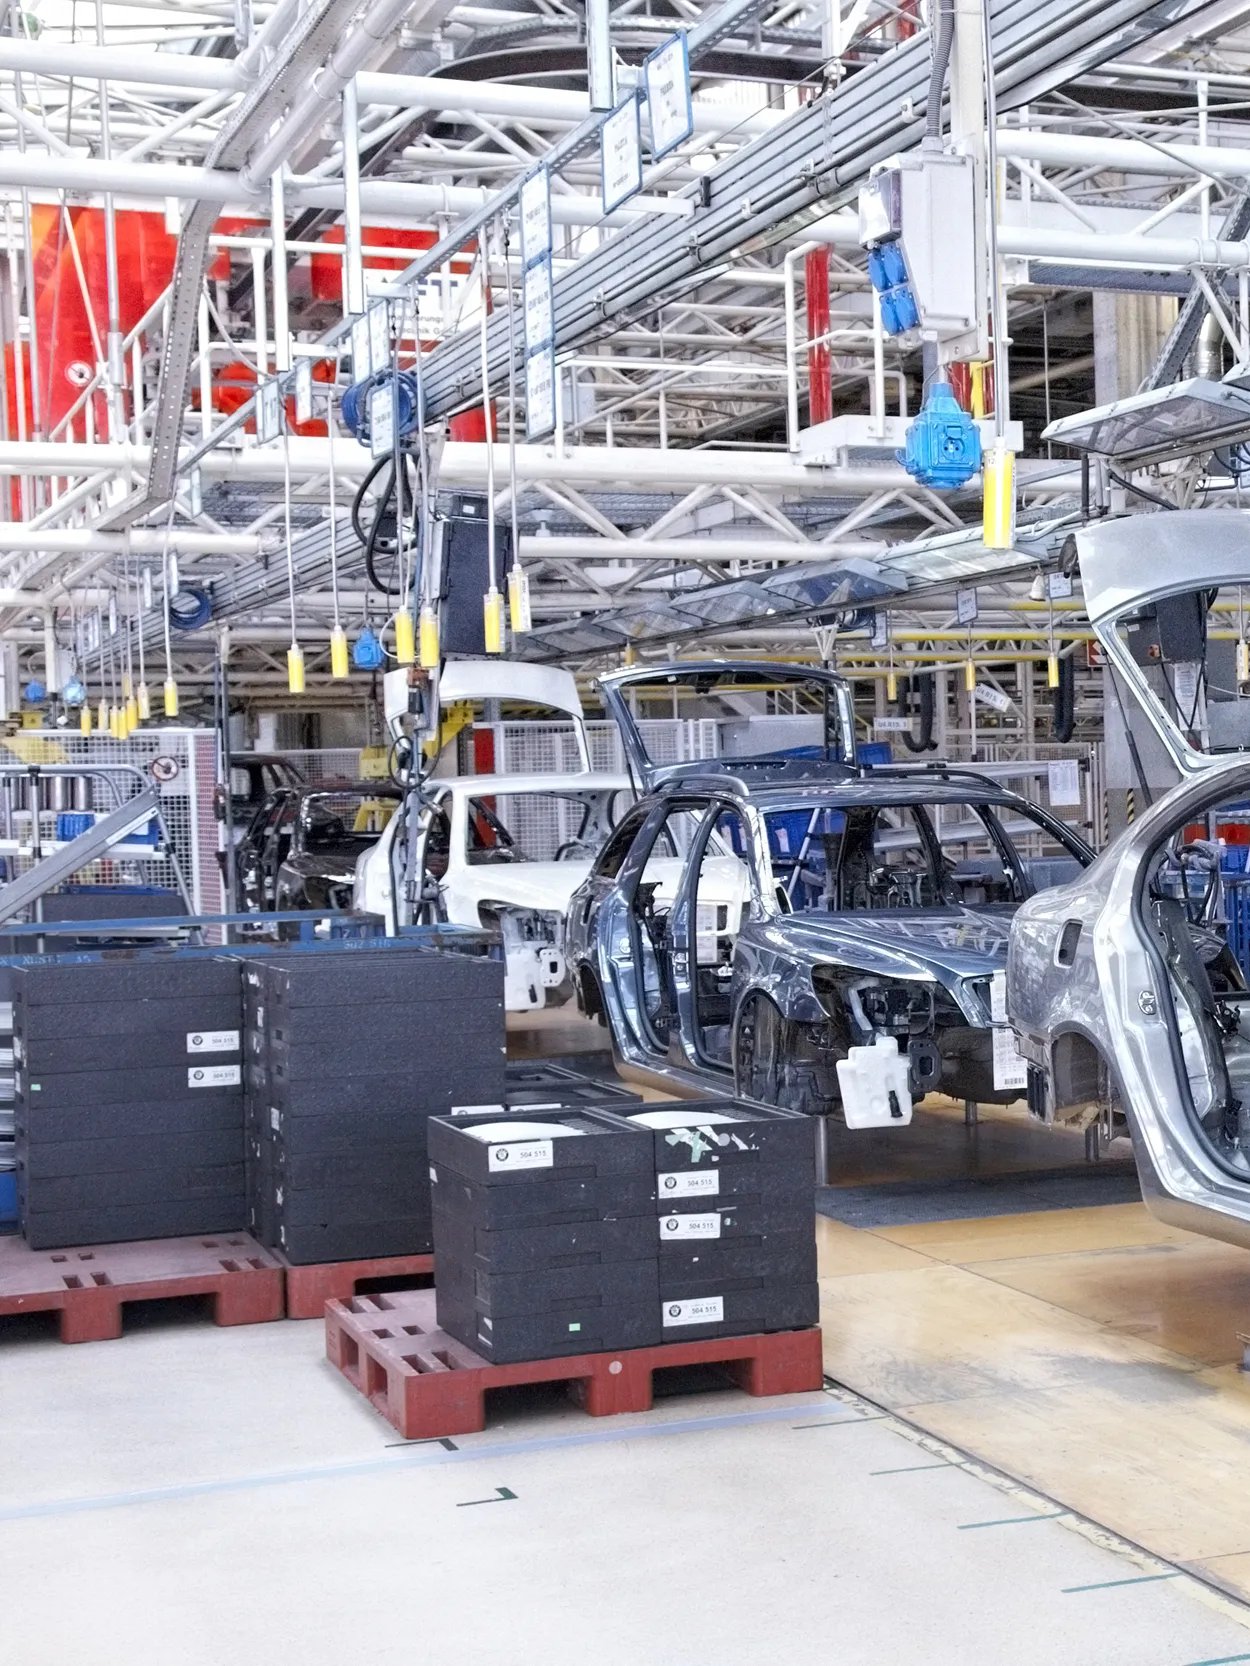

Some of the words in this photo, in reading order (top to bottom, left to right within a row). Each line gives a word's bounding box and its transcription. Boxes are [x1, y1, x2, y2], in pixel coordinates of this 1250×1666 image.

[520, 1151, 532, 1159] 504
[534, 1150, 547, 1158] 515
[700, 1178, 713, 1186] 515
[688, 1222, 700, 1230] 504
[692, 1307, 704, 1315] 504
